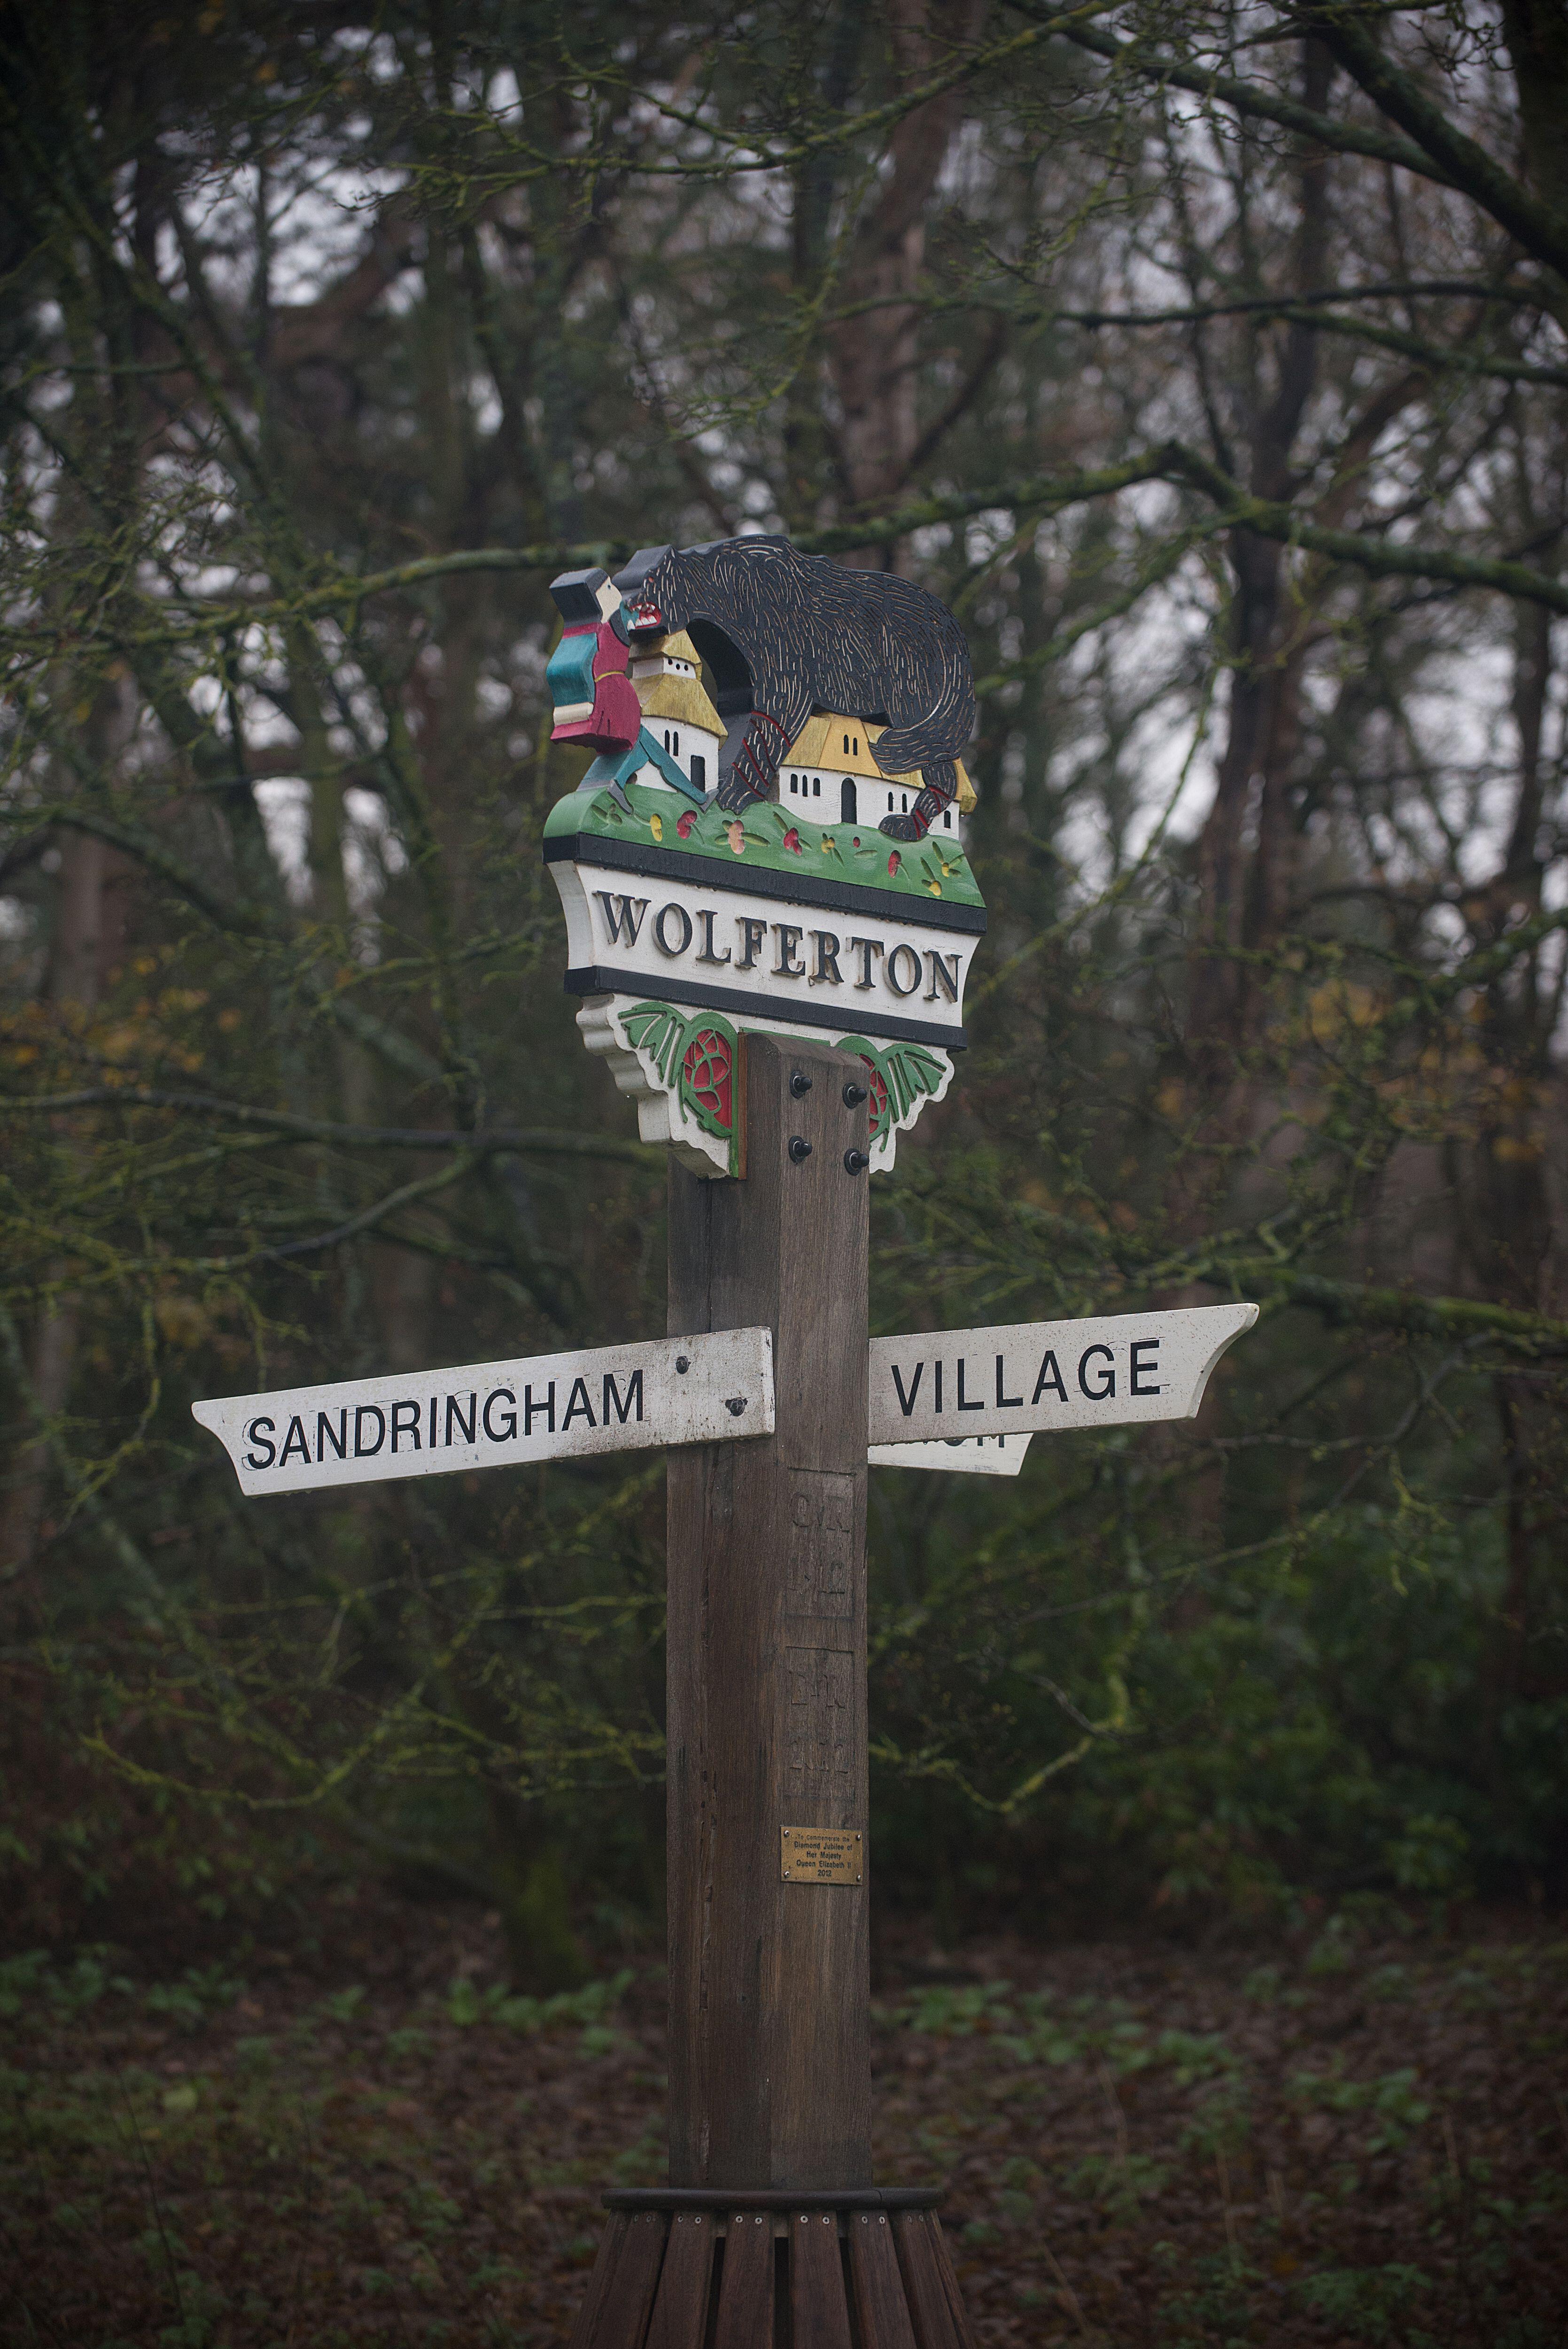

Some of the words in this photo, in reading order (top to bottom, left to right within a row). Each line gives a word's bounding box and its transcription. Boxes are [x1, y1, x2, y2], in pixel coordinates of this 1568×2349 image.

[592, 890, 963, 1003] WOLFERTON
[247, 1369, 644, 1470] SANDRINGHAM
[891, 1339, 1160, 1416] VILLAGE
